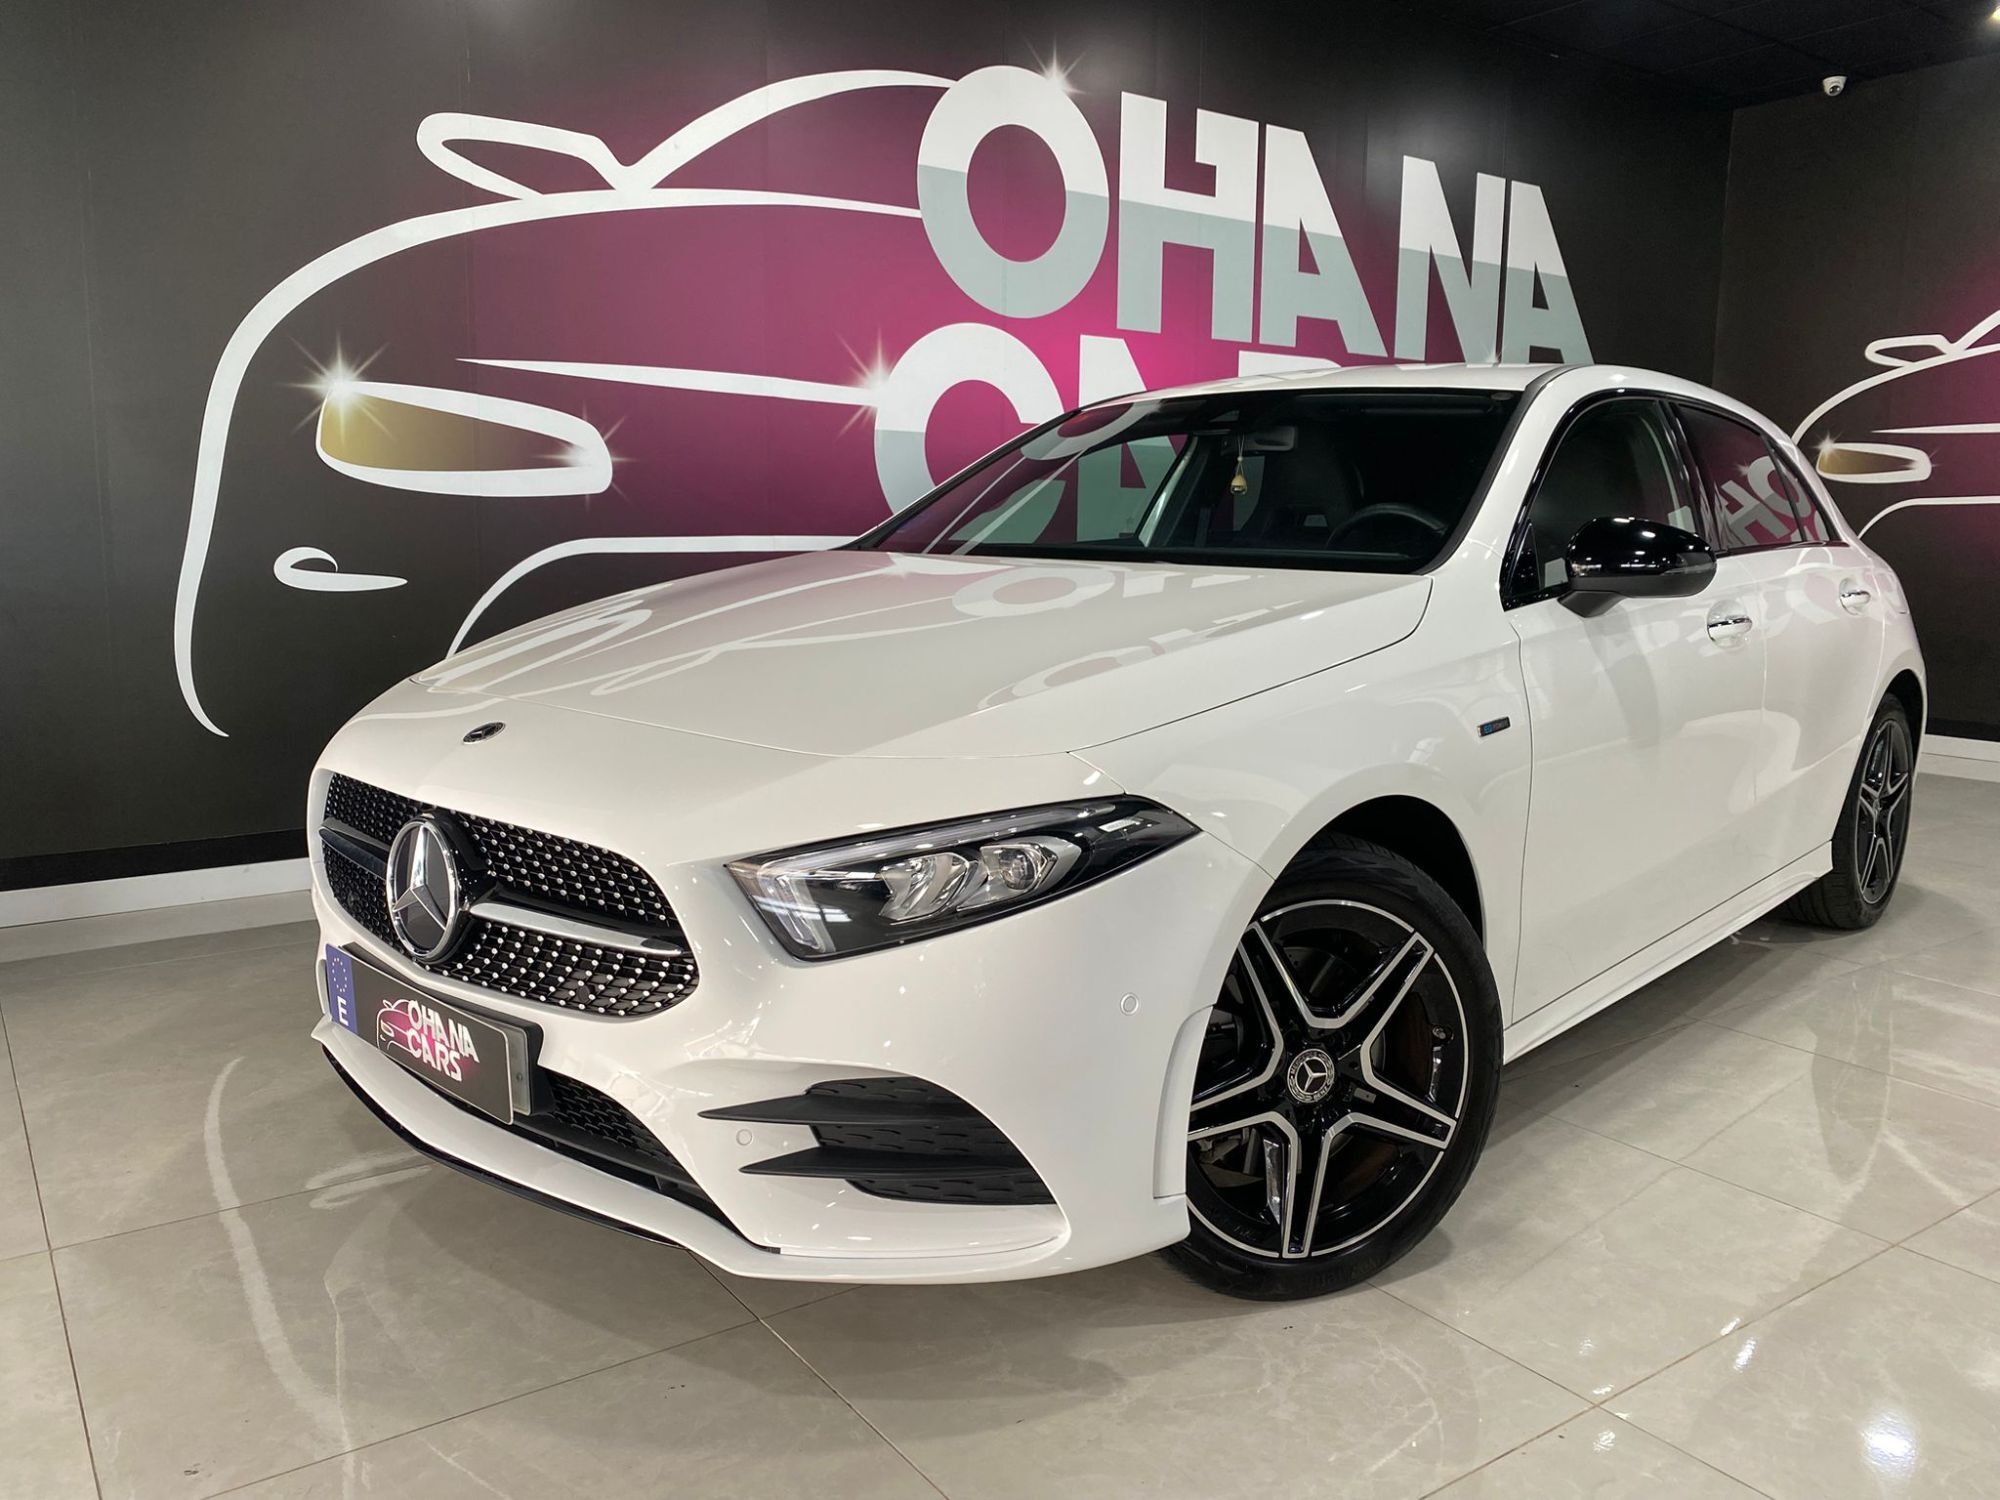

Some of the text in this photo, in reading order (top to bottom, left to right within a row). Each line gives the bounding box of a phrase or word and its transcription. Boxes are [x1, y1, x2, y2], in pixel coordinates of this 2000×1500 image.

[917, 65, 1595, 364] OHANA
[337, 995, 349, 1027] E
[407, 1000, 480, 1063] OHANA
[406, 1030, 463, 1082] CARS
